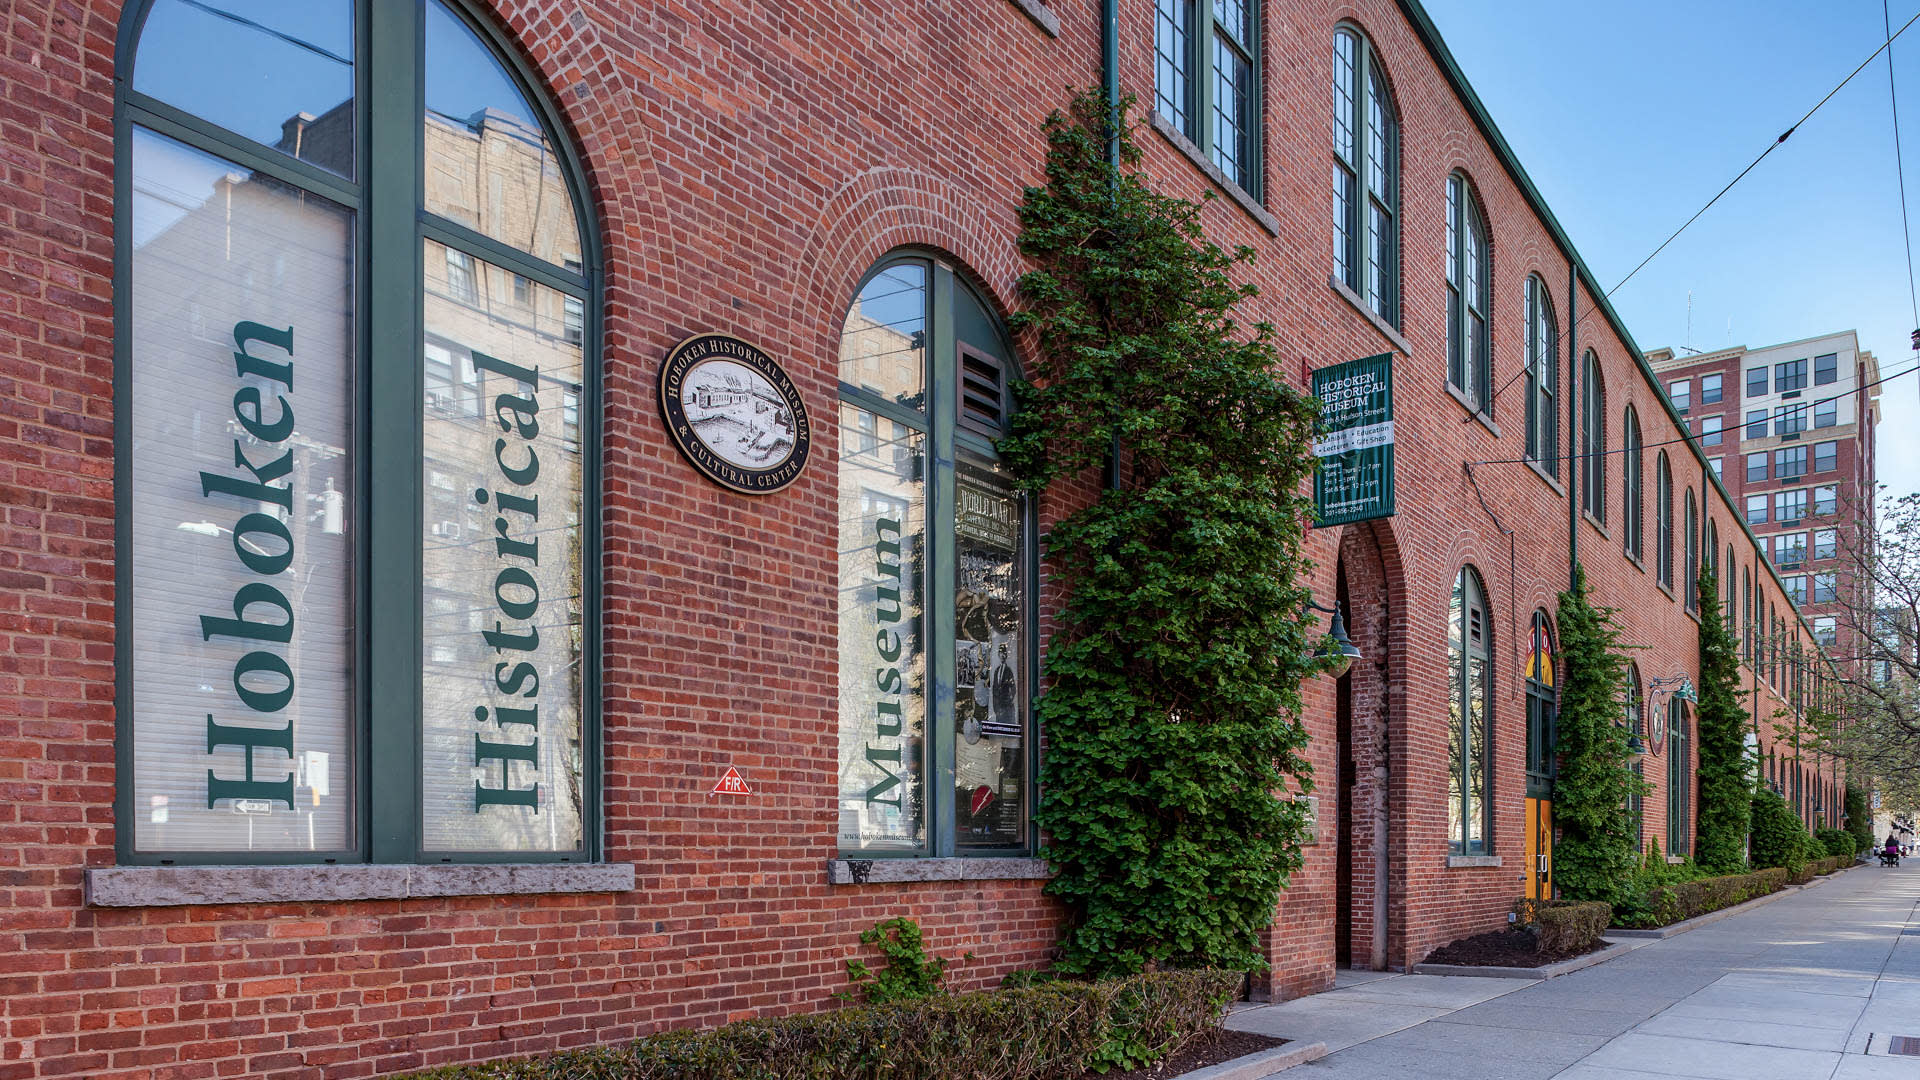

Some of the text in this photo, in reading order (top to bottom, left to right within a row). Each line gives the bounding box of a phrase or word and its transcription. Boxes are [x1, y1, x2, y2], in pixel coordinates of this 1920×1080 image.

[668, 340, 808, 441] HOBOKEN HISTORICAL MUSEUM
[1320, 372, 1375, 393] HOBOKEN
[1320, 381, 1386, 403] HISTORICAL
[1320, 395, 1369, 415] MUSEUM
[1364, 407, 1386, 417] Streets
[1356, 426, 1389, 437] Education
[1323, 441, 1349, 453] Lectures
[1370, 435, 1387, 444] Shop
[679, 425, 799, 487] & CULTURAL CENTER
[199, 319, 295, 812] Hoboken
[471, 350, 540, 815] Historical
[866, 516, 902, 813] Museum
